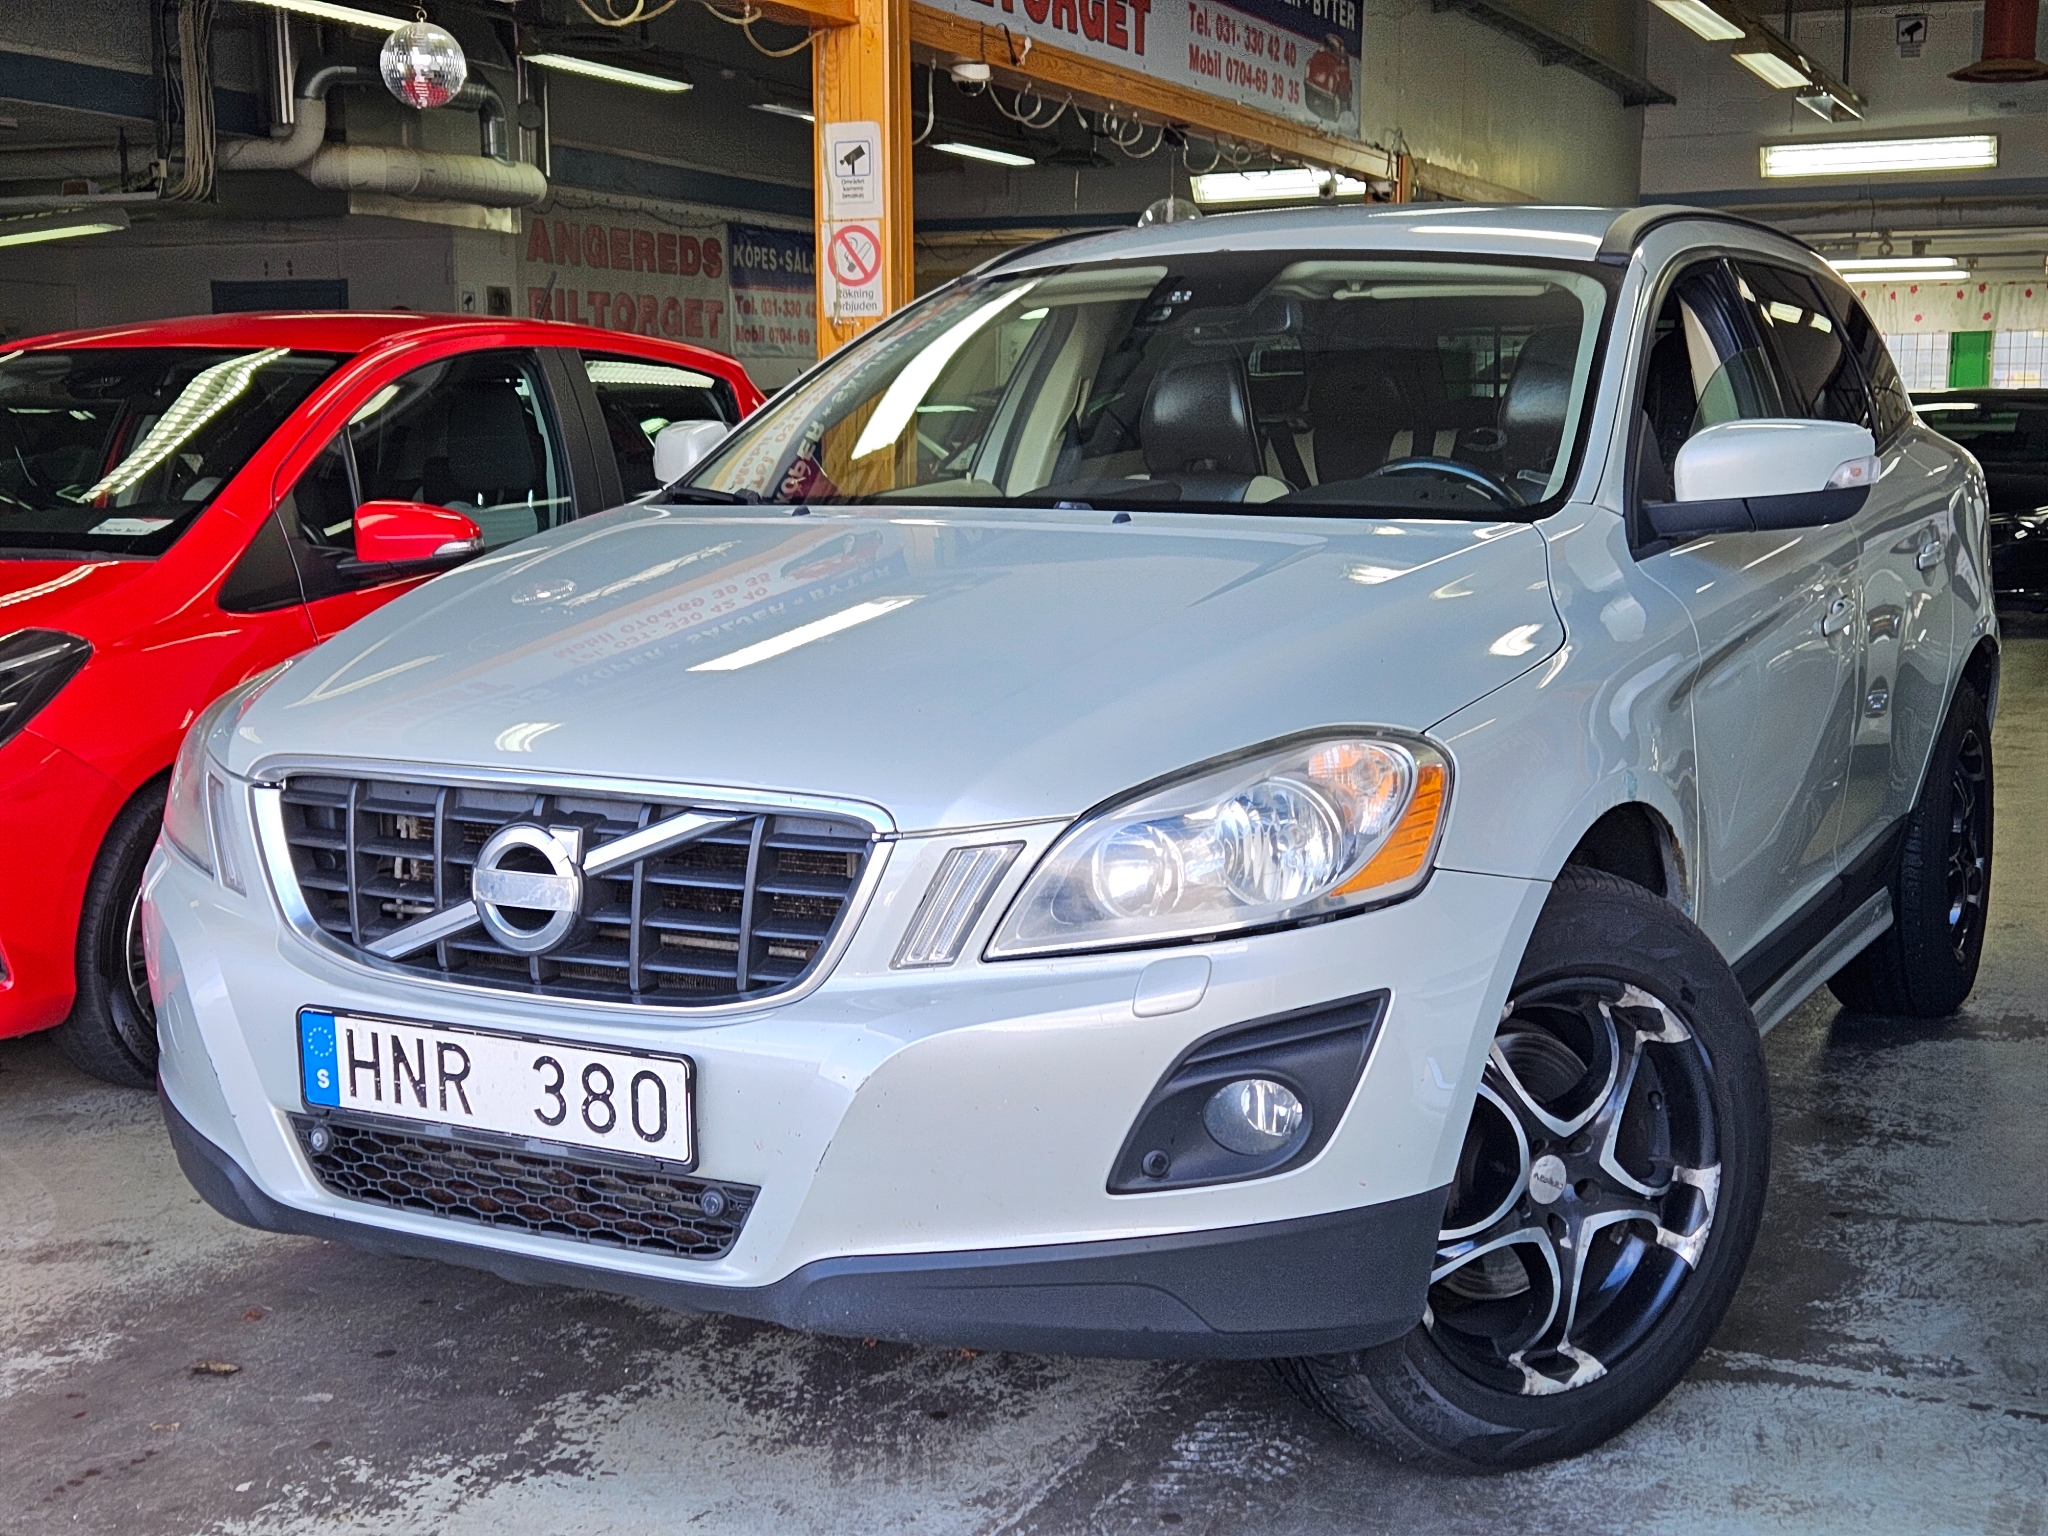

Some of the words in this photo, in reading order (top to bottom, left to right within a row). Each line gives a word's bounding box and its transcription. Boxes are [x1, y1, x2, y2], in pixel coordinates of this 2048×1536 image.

[1188, 1, 1211, 37] Tel.
[1244, 24, 1264, 57] 330
[1267, 35, 1280, 63] 42
[1283, 41, 1297, 69] 40
[1188, 43, 1222, 79] Mobil
[1226, 56, 1268, 95] 0704-69
[1272, 72, 1284, 99] 39
[1288, 79, 1300, 104] 35
[526, 218, 723, 279] ANGEREDS
[527, 287, 723, 339] BILTORGET
[735, 294, 757, 316] Tel.
[735, 324, 765, 344] Mobil
[317, 1068, 331, 1089] S
[346, 1029, 473, 1116] HNR
[532, 1055, 667, 1143] 380
